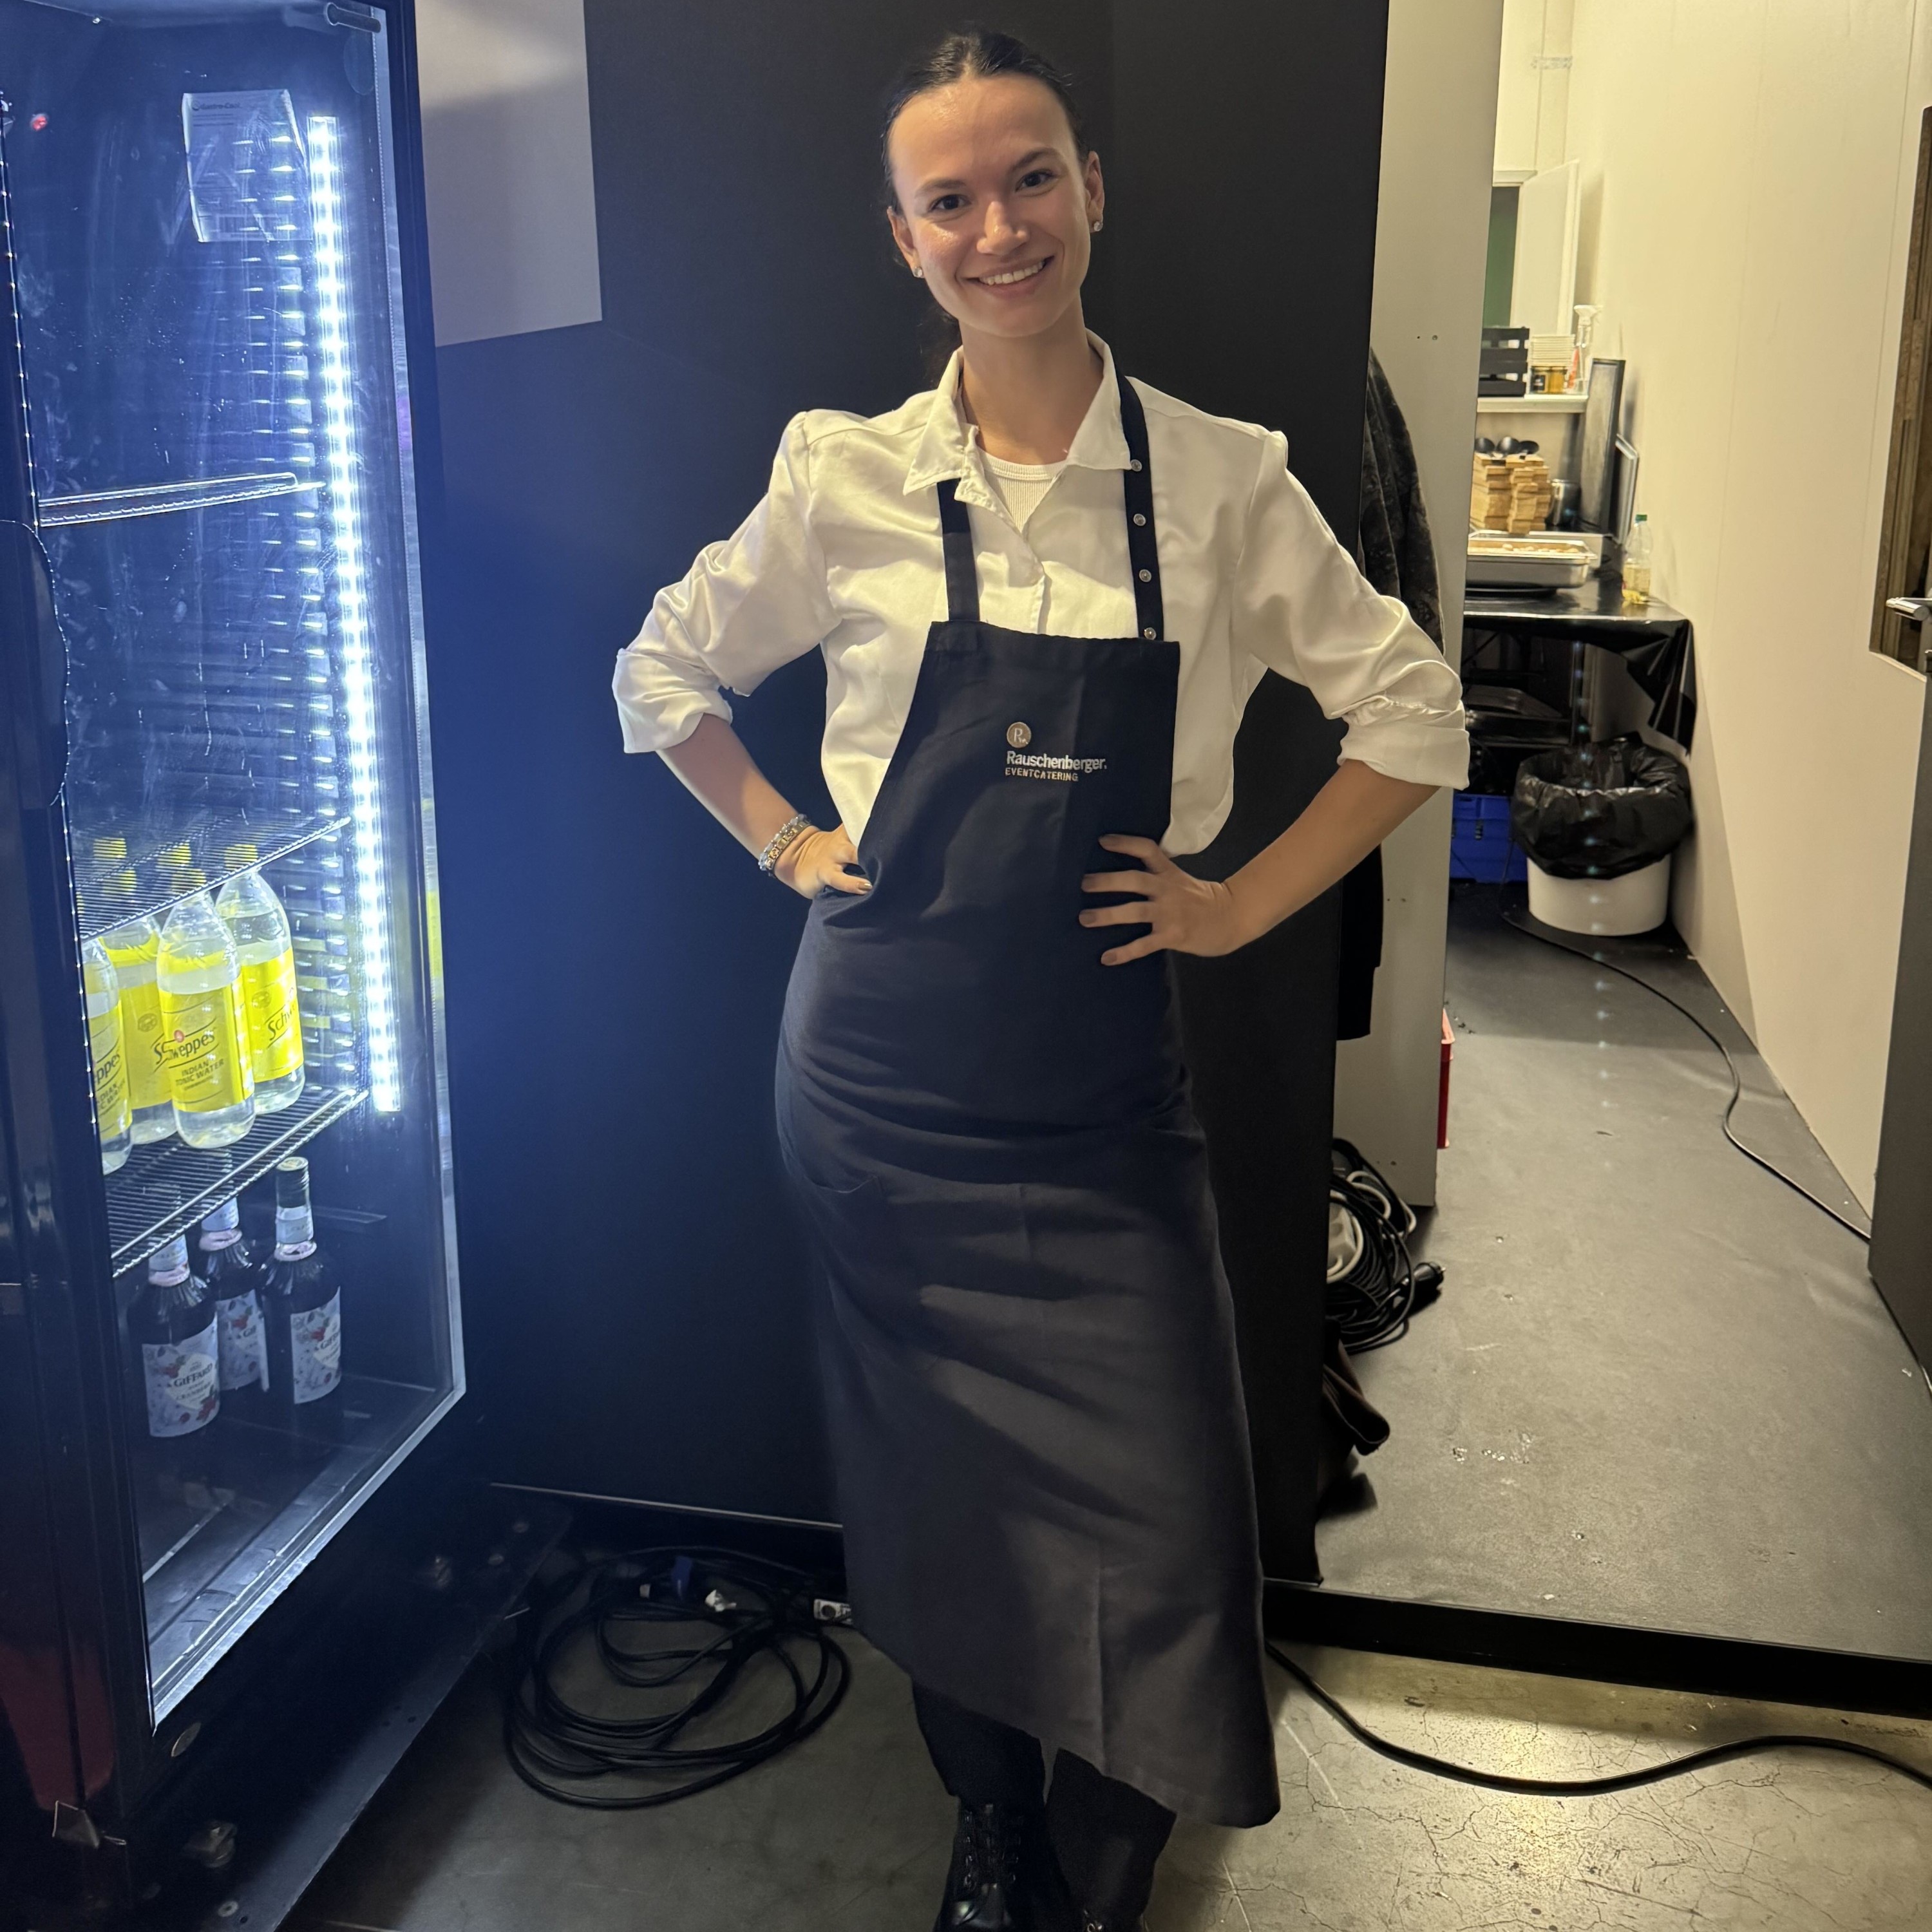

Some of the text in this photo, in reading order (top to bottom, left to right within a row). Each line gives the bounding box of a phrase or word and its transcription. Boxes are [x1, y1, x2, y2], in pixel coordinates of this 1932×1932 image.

[1007, 750, 1107, 773] Rauschenberger.
[1005, 767, 1079, 782] EVENTCATERING
[182, 1060, 209, 1077] INDIAN
[196, 1058, 224, 1079] WATER
